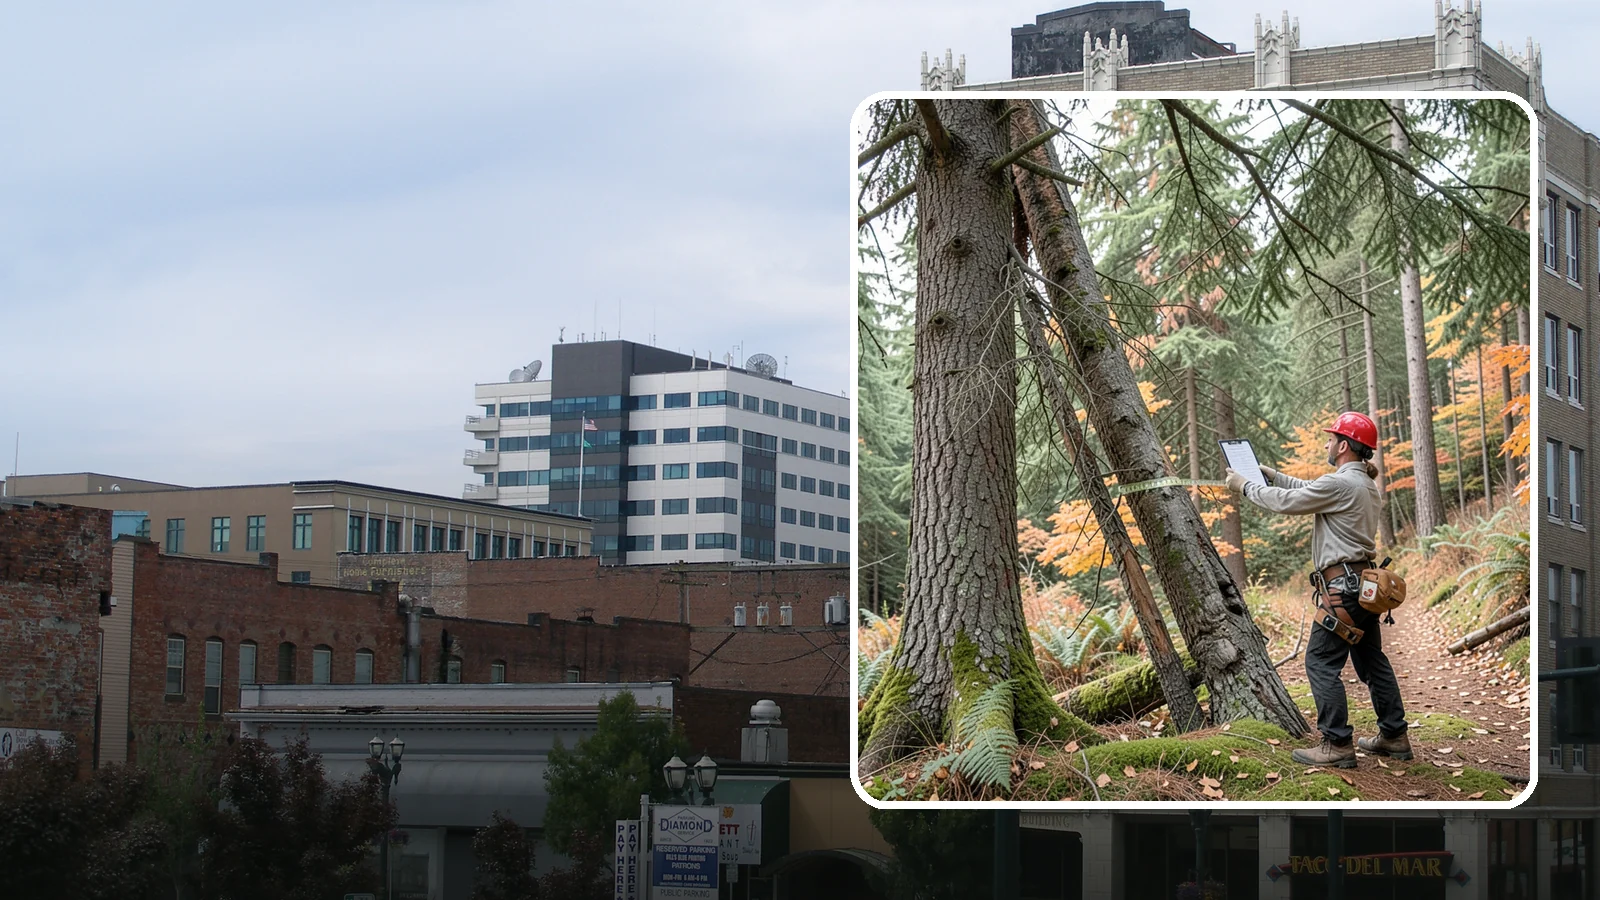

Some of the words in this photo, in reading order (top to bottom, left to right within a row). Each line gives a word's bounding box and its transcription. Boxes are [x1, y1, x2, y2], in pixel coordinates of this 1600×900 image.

[343, 568, 368, 577] Home
[370, 566, 427, 577] Furnishers
[660, 818, 713, 833] DIAMOND
[1022, 815, 1070, 827] BUILDING
[617, 825, 625, 852] PAY
[628, 825, 637, 852] PAY
[689, 846, 716, 854] PARKING
[671, 862, 701, 870] PATRONS
[1346, 856, 1385, 876] DEL
[1393, 856, 1443, 877] MAR
[616, 856, 625, 893] HERE
[627, 856, 636, 893] HERE
[660, 888, 682, 897] PUBLIC
[683, 889, 710, 898] PARKING
